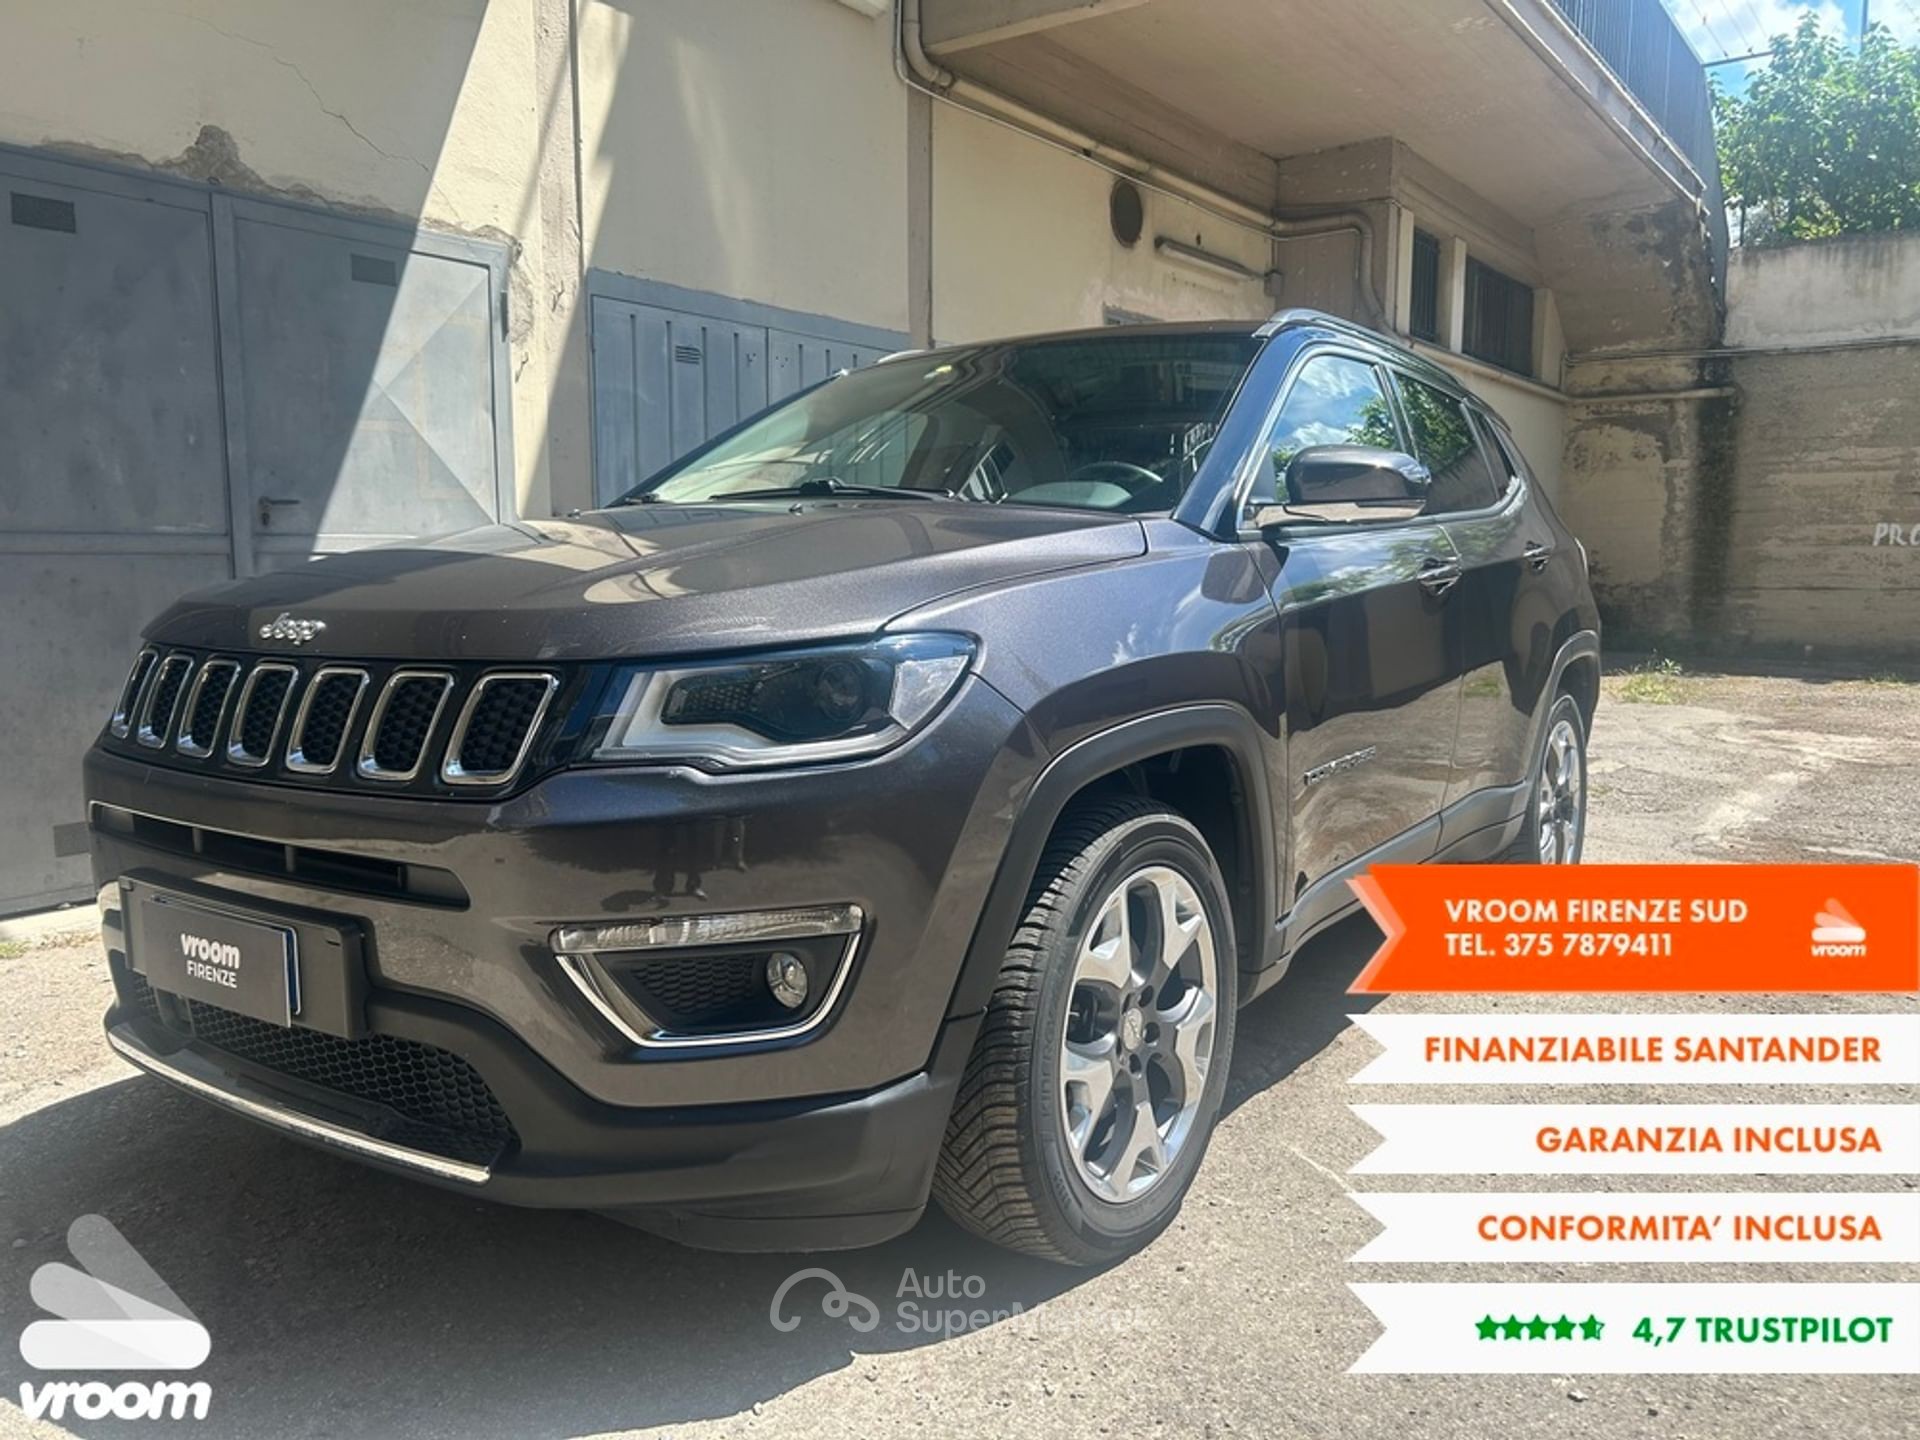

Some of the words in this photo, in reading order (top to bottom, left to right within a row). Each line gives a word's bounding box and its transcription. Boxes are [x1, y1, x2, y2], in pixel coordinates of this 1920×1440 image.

[259, 612, 326, 645] Jeep
[180, 932, 241, 969] vroom
[187, 959, 238, 989] FIRENZE
